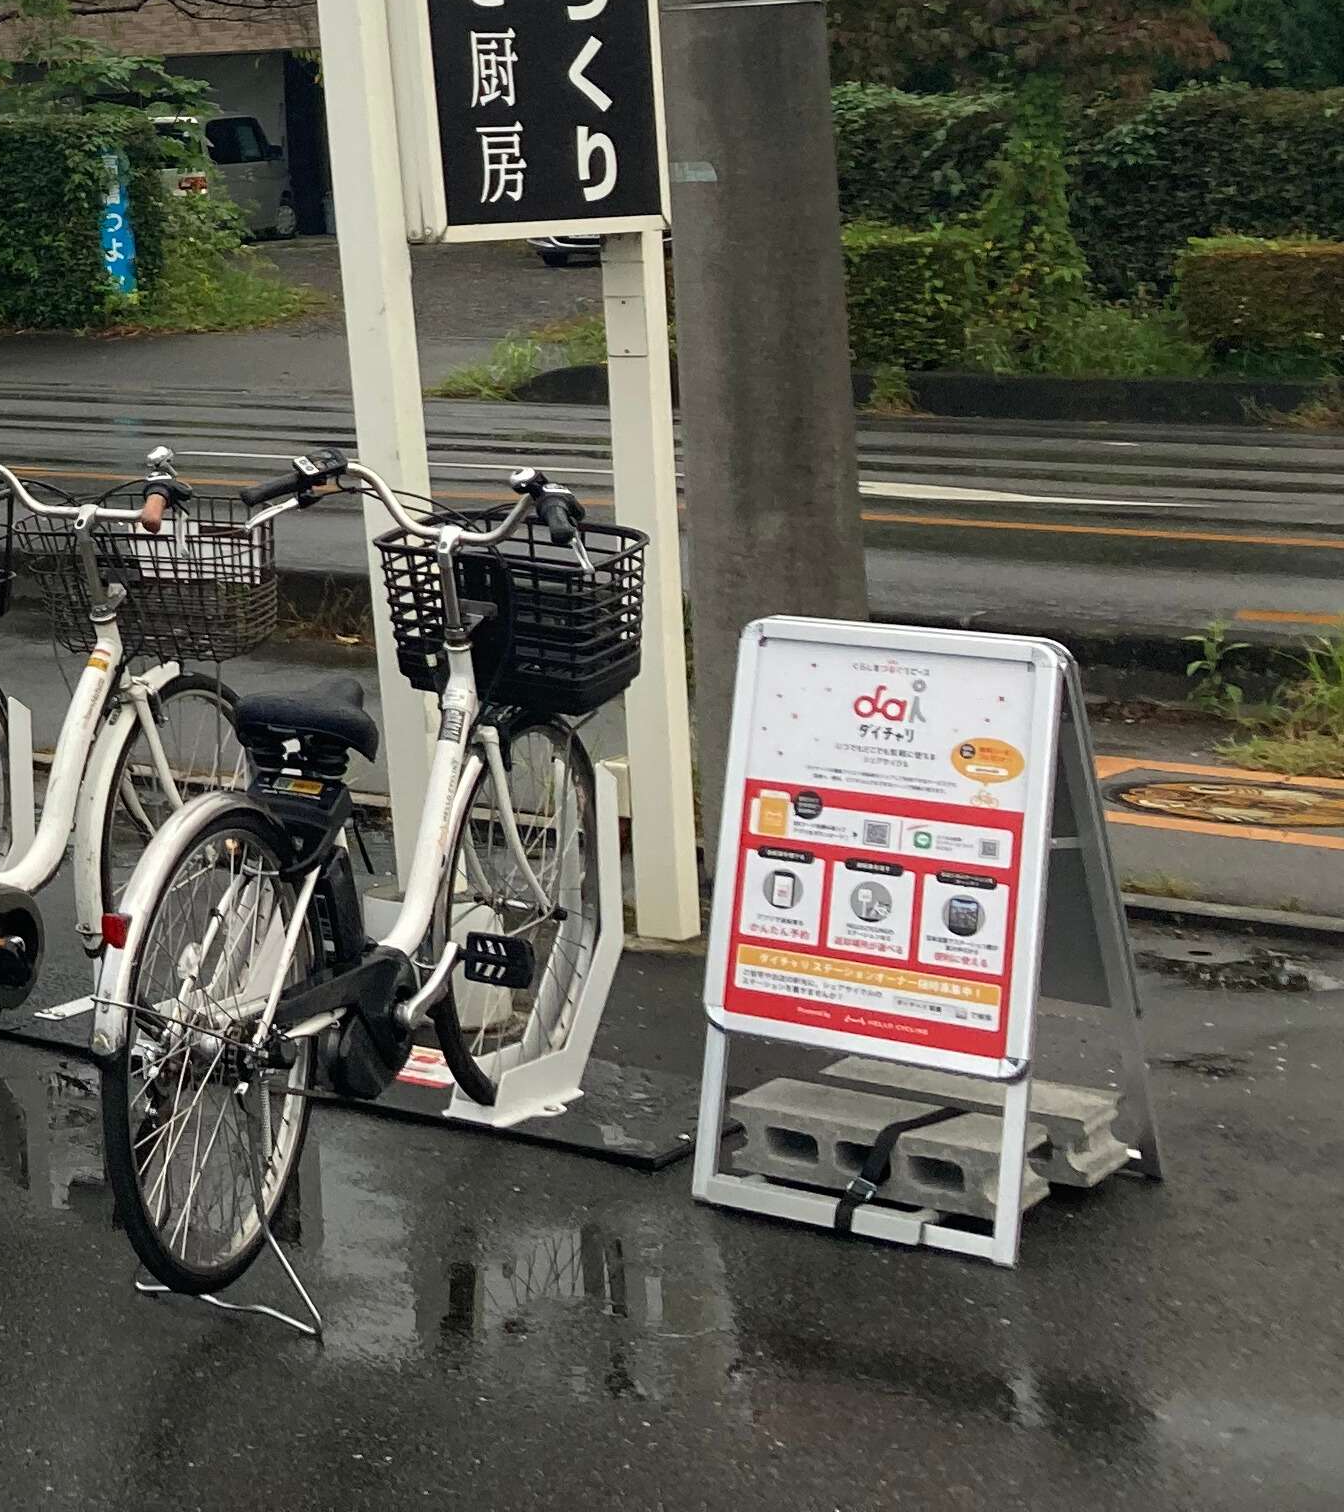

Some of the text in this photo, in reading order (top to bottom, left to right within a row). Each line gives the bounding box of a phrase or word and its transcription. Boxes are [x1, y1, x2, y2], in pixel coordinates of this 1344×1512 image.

[853, 679, 927, 723] dai
[858, 724, 915, 743] ダイチャリ
